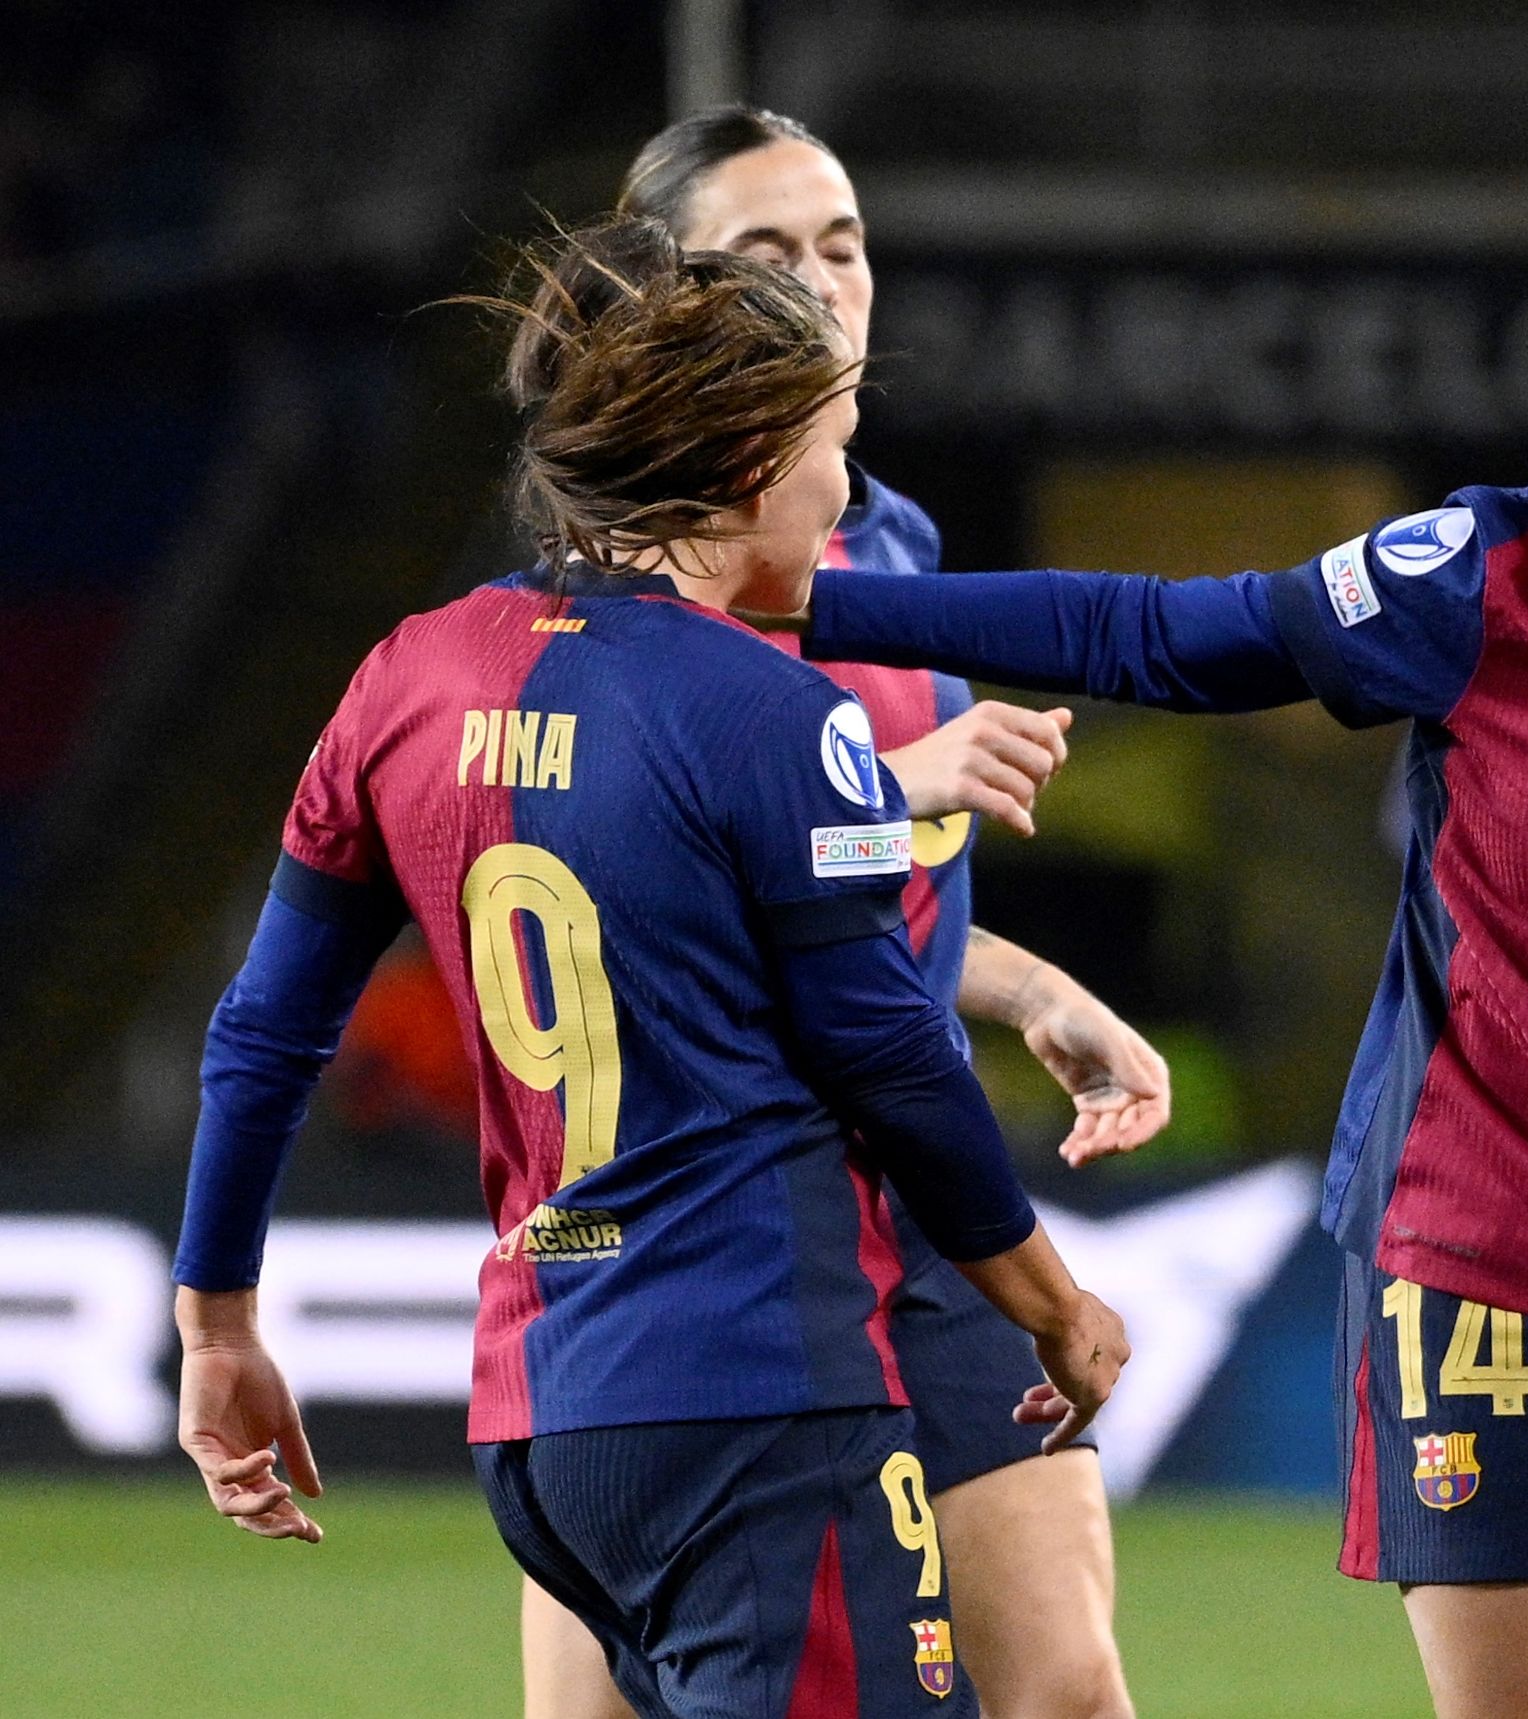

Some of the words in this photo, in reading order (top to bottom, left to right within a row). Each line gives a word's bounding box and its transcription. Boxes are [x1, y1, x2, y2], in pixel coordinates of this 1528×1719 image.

[458, 709, 577, 790] PINA
[816, 831, 845, 842] UEFA
[461, 843, 622, 1192] 9
[521, 1222, 622, 1252] ACNUR
[880, 1452, 941, 1597] 9
